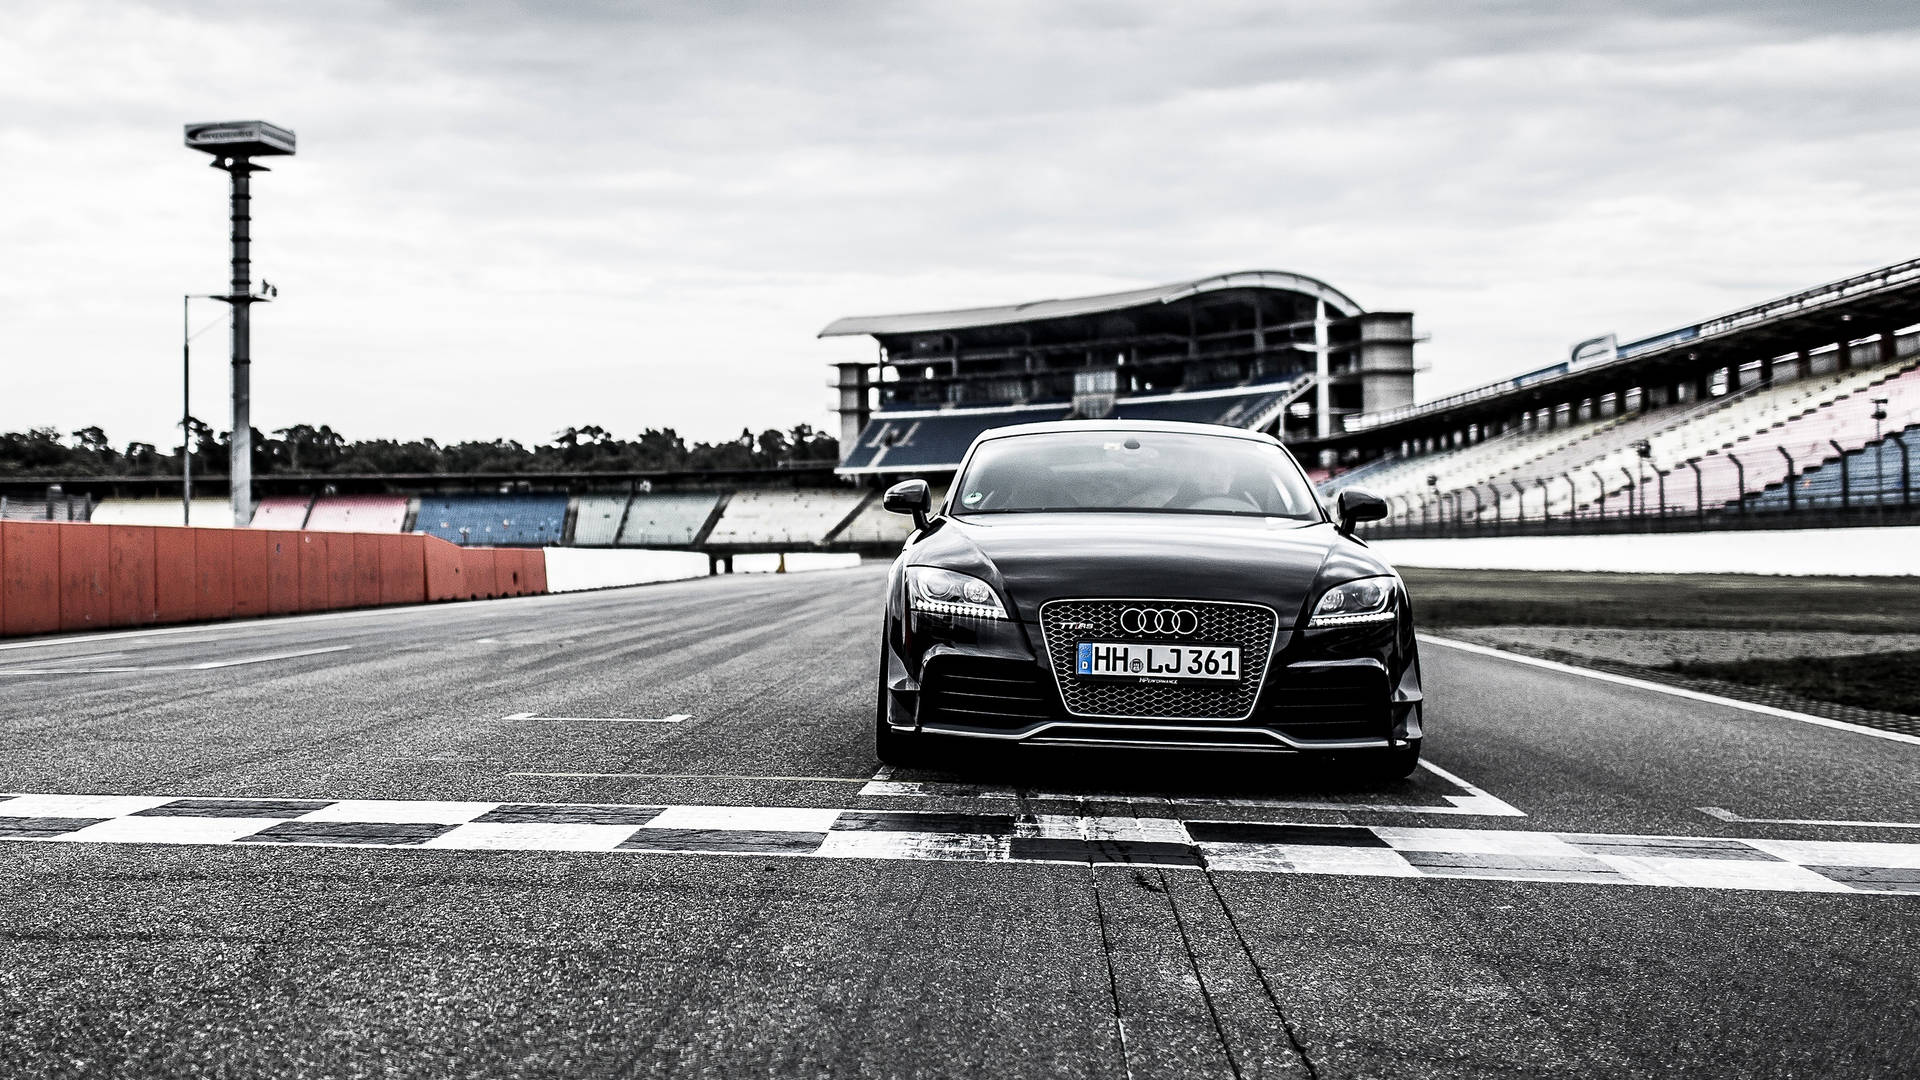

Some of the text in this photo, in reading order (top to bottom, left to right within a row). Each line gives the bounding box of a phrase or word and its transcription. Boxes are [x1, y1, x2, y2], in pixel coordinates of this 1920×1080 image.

[1081, 661, 1088, 669] D
[1094, 646, 1237, 676] HH LJ 361
